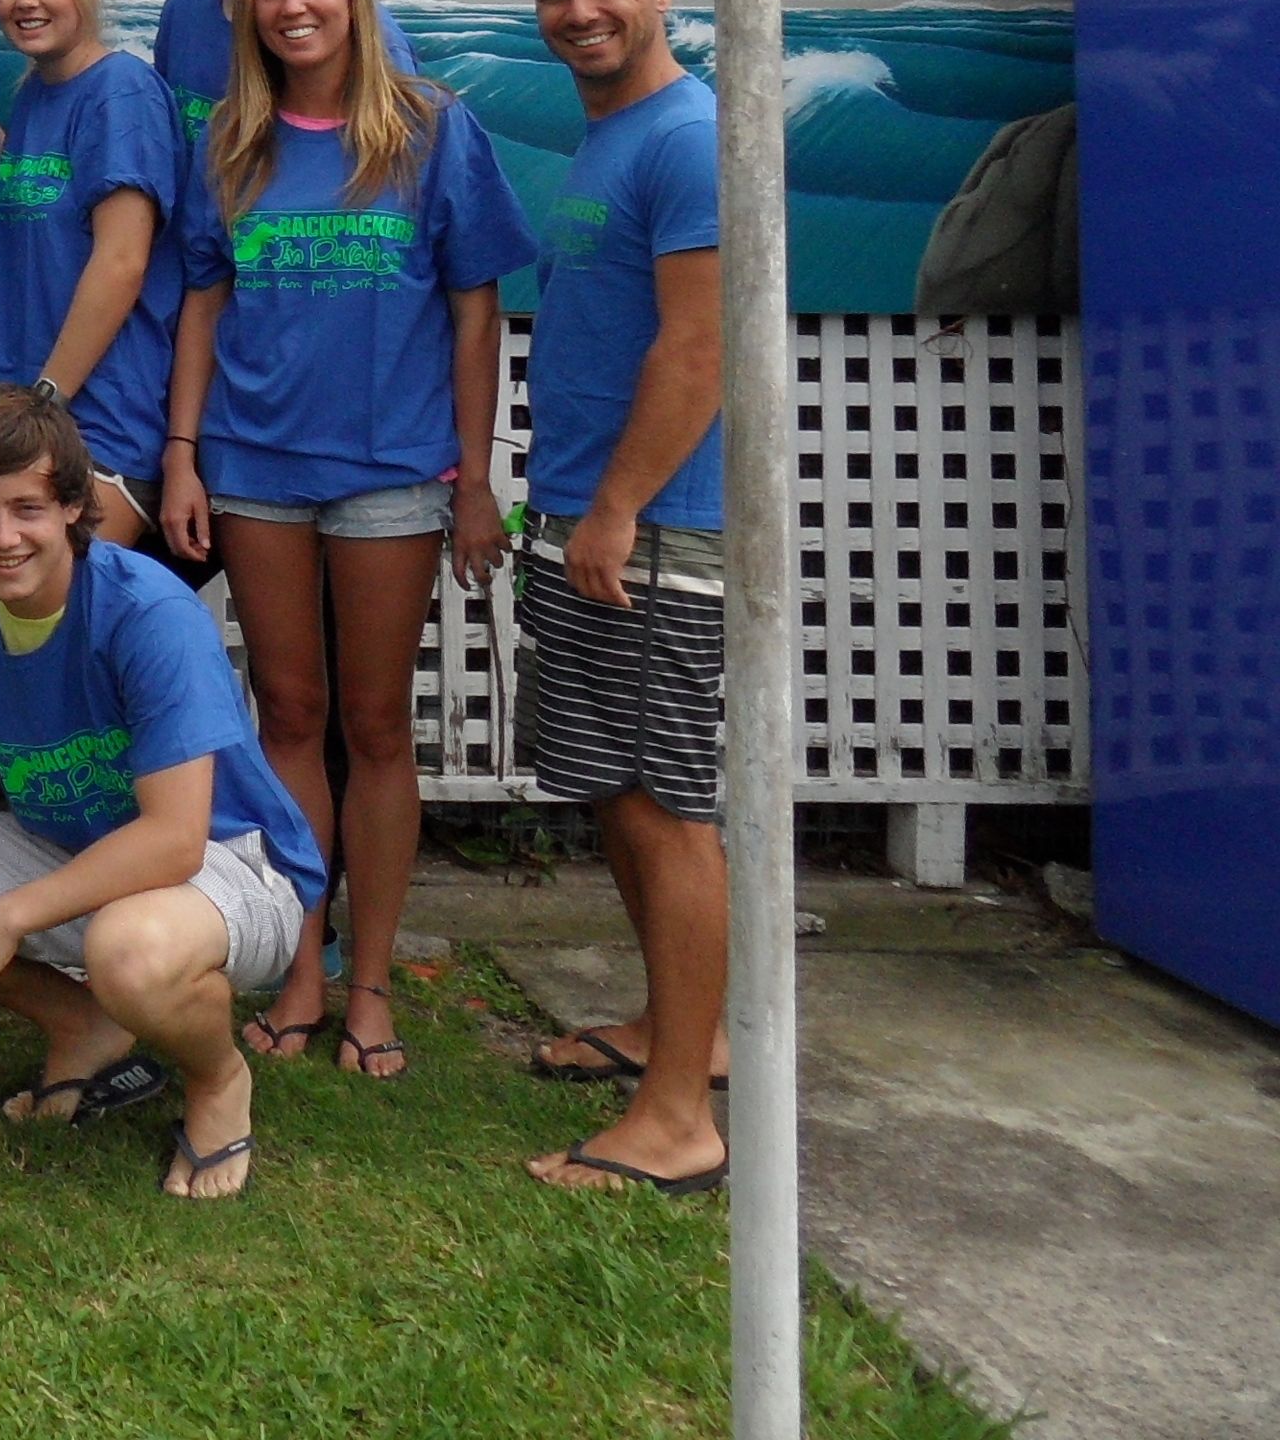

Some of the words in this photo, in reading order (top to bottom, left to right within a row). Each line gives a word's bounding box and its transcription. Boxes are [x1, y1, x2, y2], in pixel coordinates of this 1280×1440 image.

[277, 214, 415, 243] BACKPACKERS
[271, 239, 305, 271] In
[311, 275, 339, 298] party
